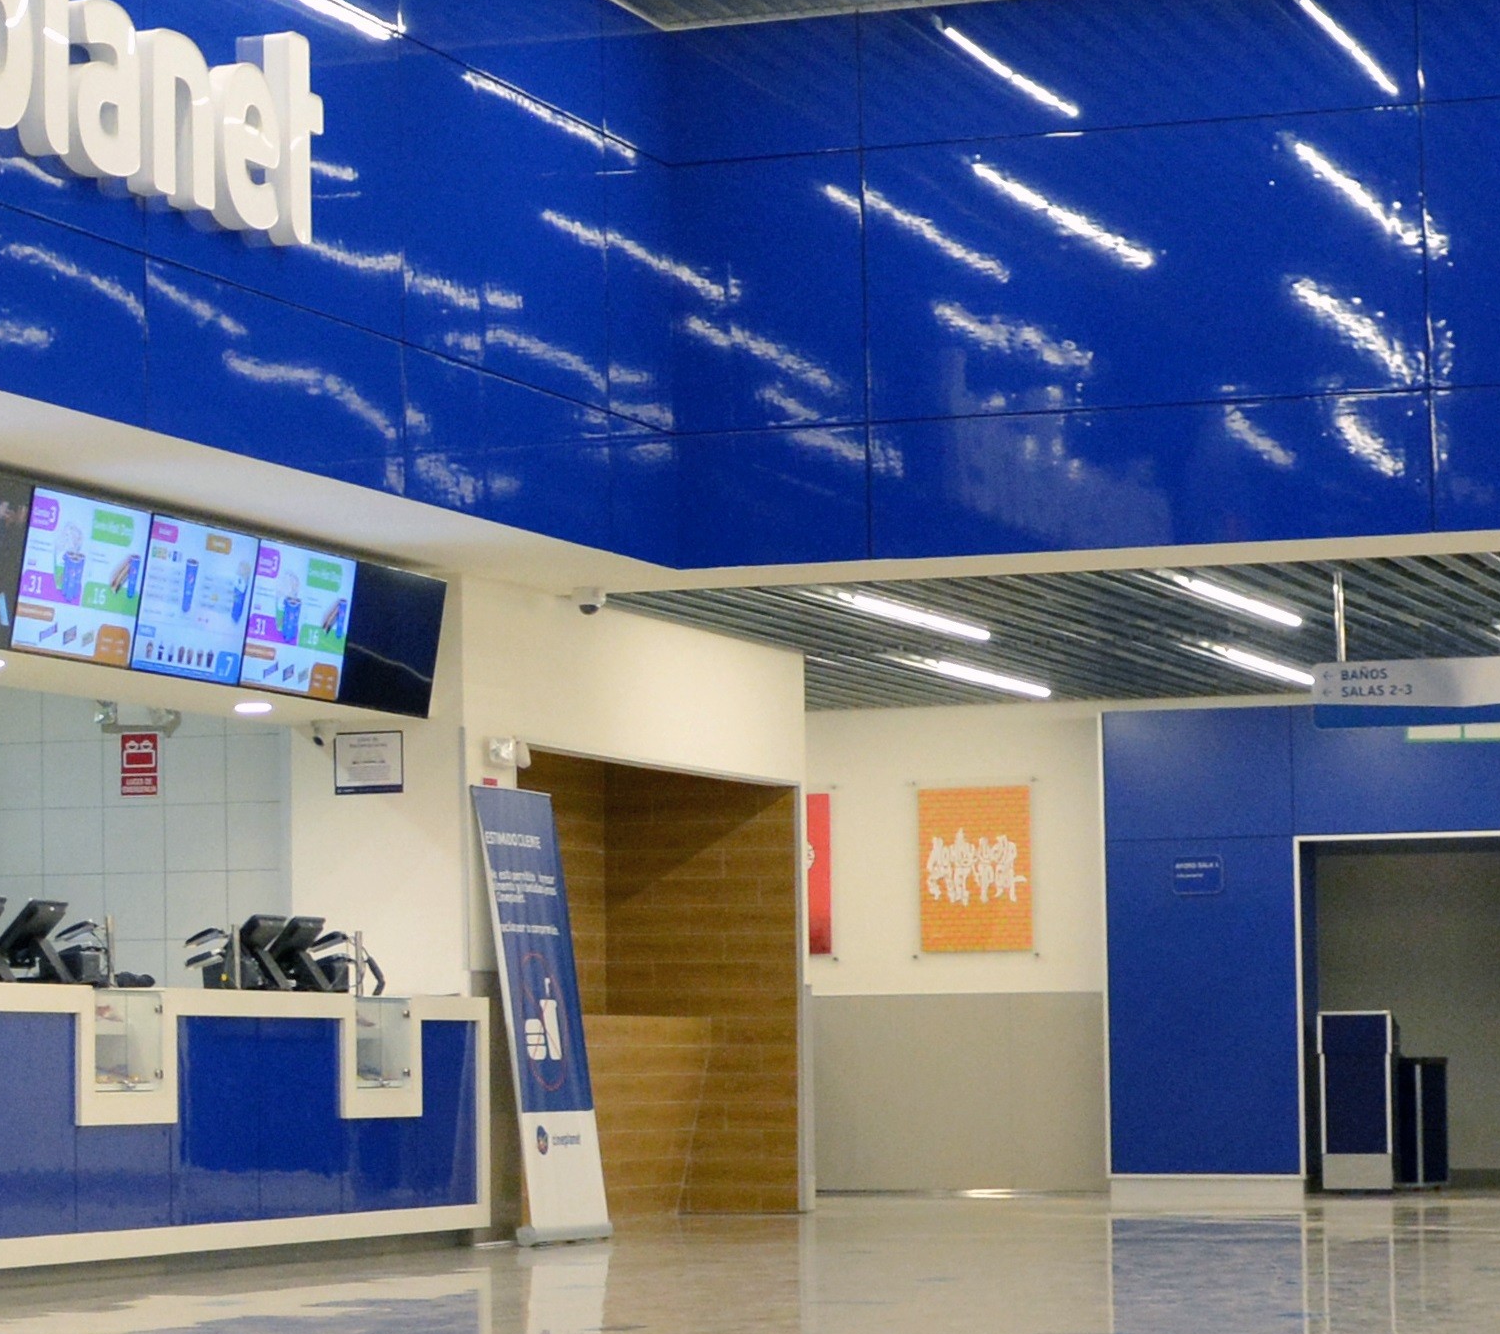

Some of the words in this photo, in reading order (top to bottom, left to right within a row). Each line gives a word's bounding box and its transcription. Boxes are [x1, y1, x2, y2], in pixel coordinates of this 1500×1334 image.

[1340, 666, 1388, 681] BAÑOS
[1341, 685, 1385, 697] SALAS
[1389, 683, 1413, 696] 2-3
